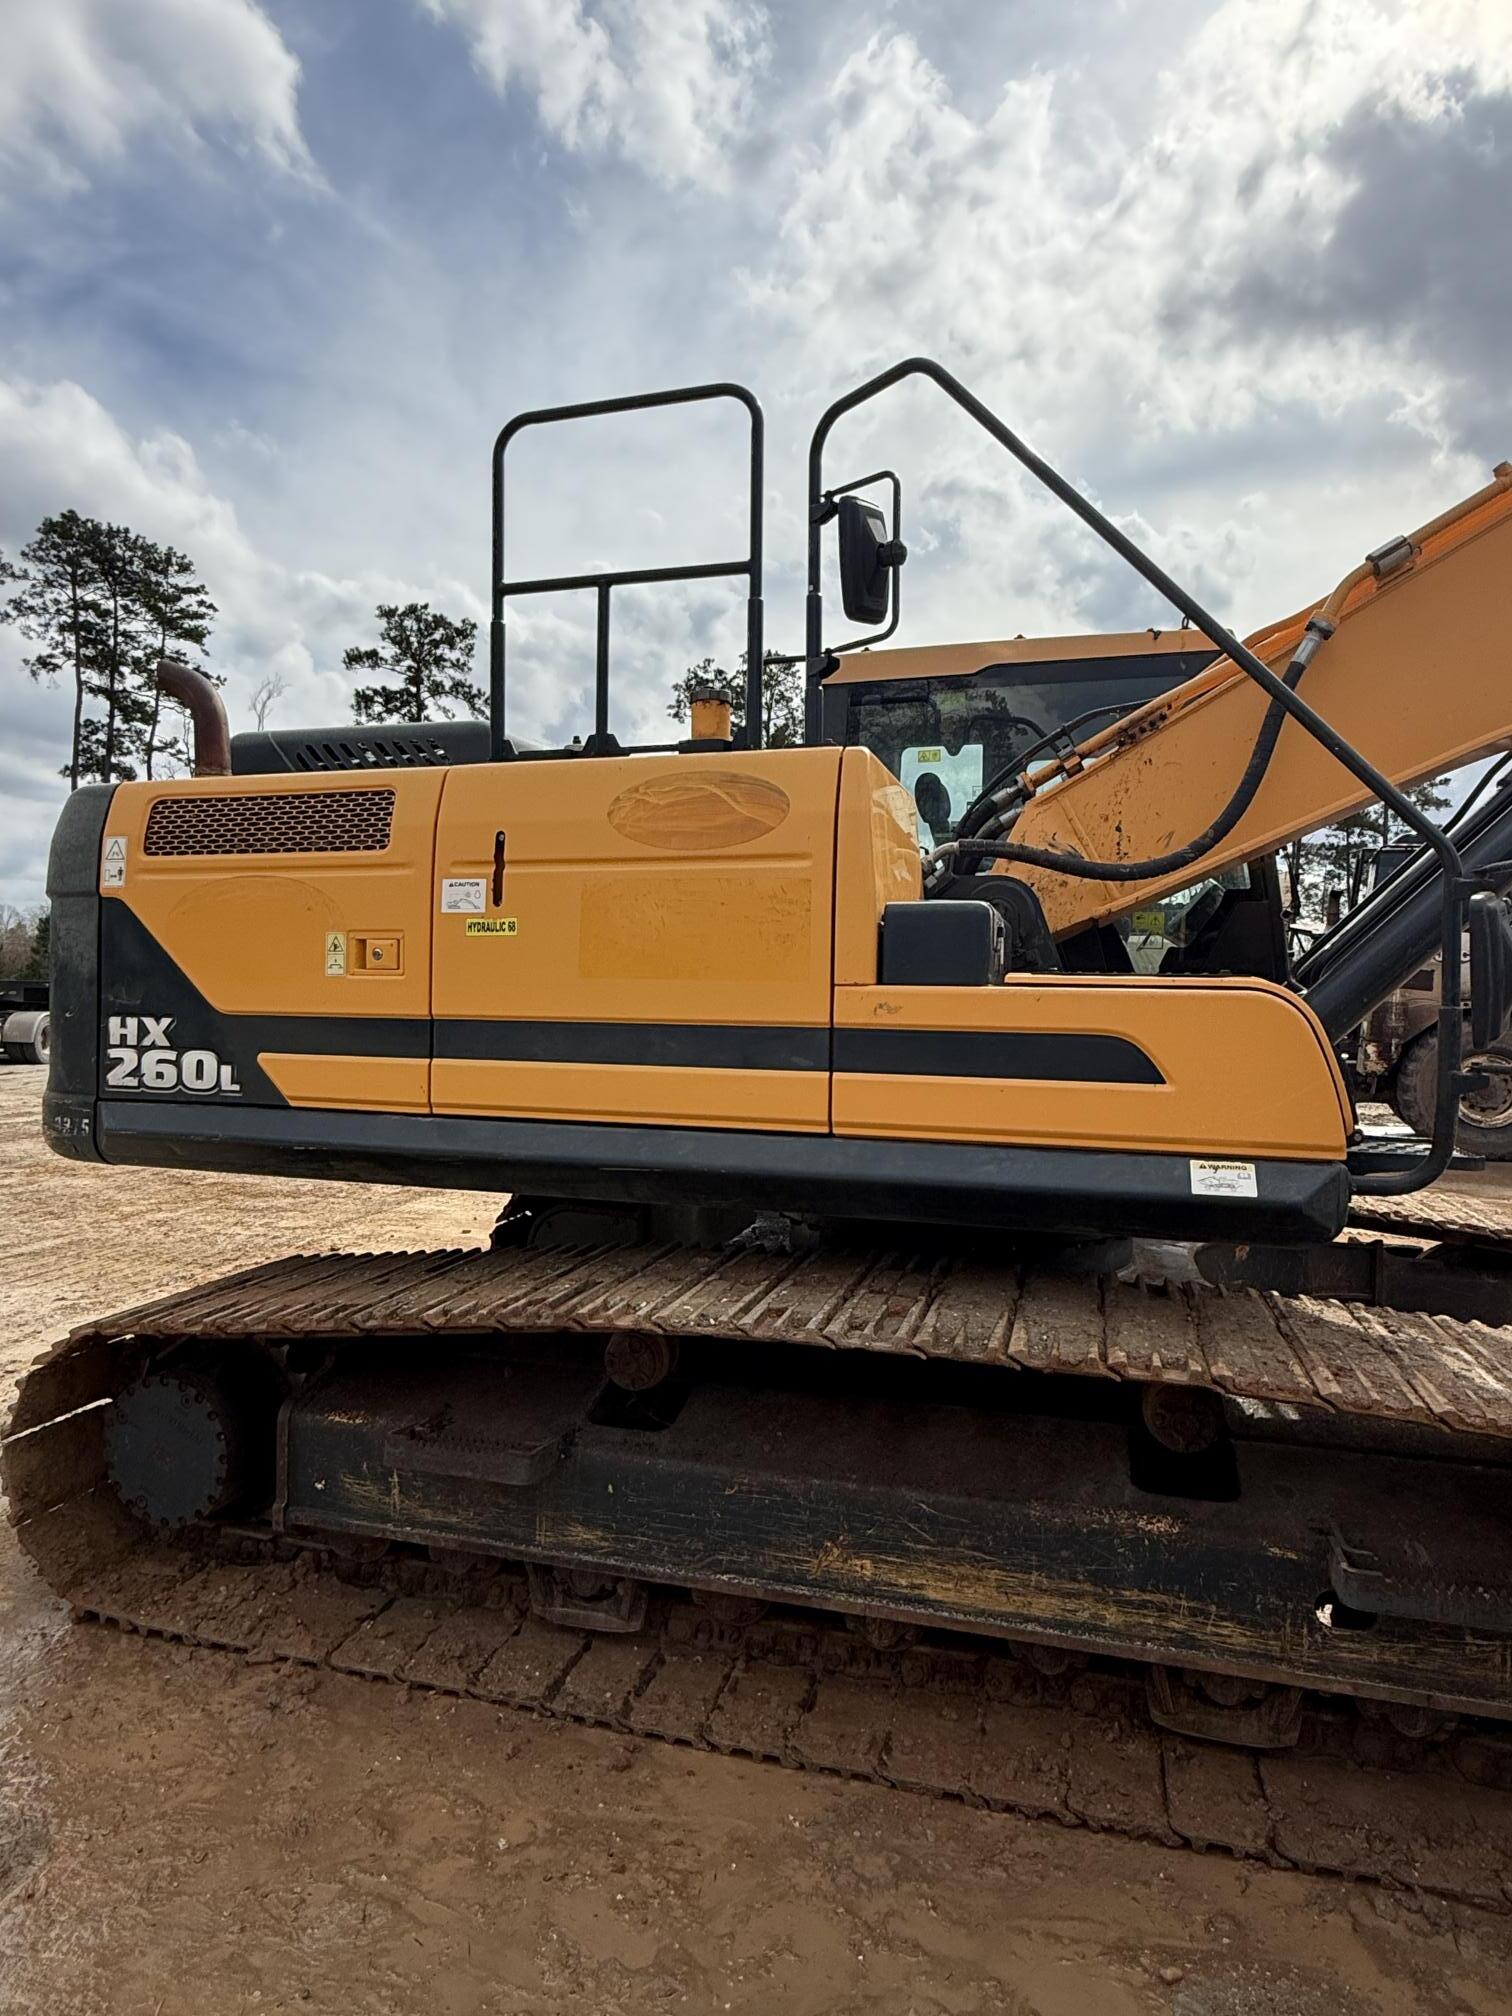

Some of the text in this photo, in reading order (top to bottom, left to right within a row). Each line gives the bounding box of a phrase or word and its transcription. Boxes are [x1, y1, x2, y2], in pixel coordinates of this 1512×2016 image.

[467, 921, 516, 932] HYDRAULIC 68
[109, 1016, 174, 1047] HX
[106, 1049, 240, 1092] 260L
[1208, 1163, 1248, 1171] WARNING
